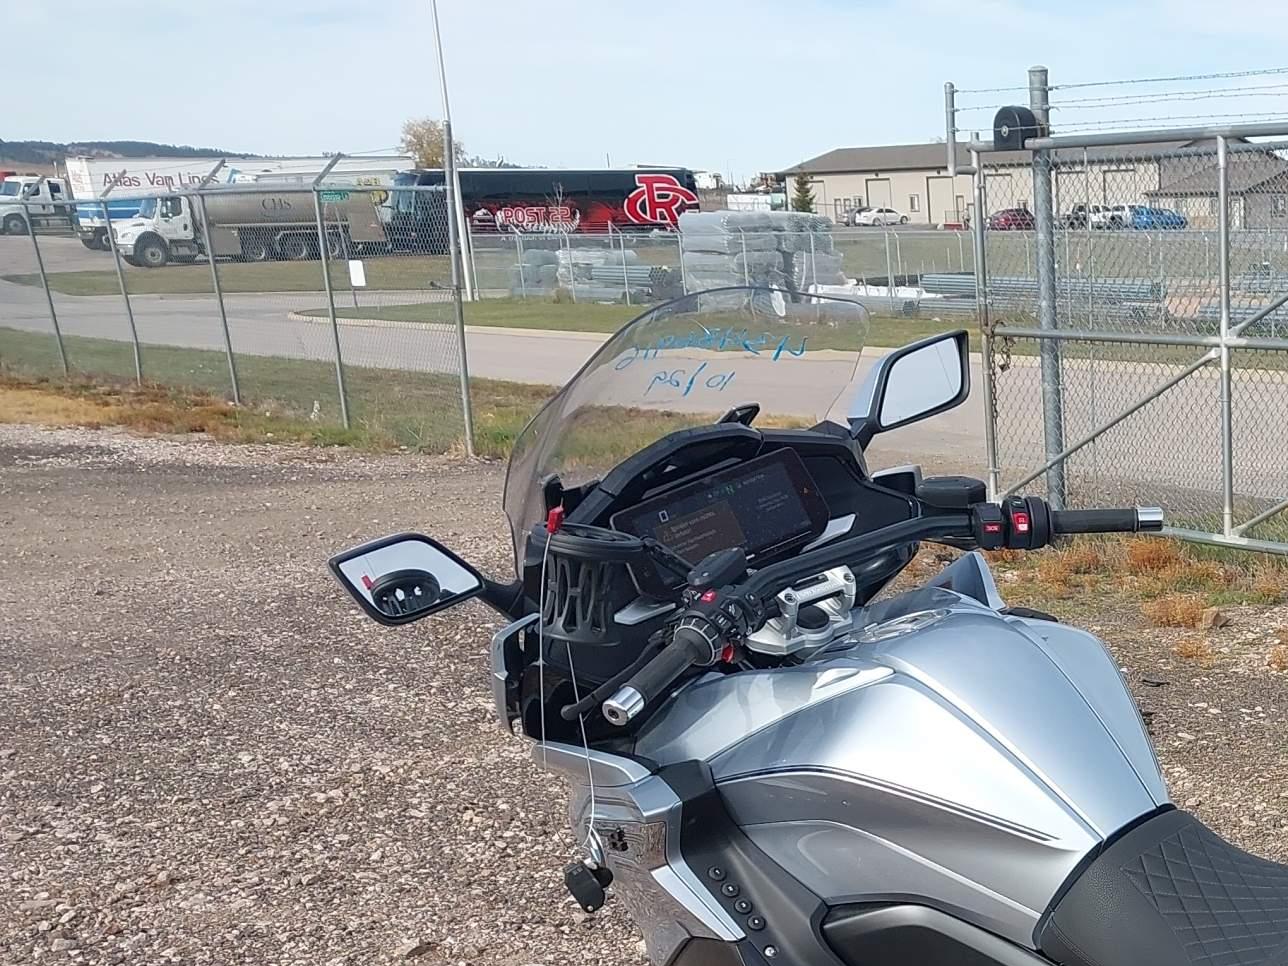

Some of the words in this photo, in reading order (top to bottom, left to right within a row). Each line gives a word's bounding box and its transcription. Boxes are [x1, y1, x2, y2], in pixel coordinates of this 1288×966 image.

[145, 172, 174, 186] Van
[502, 206, 545, 225] POST
[548, 206, 572, 224] 22
